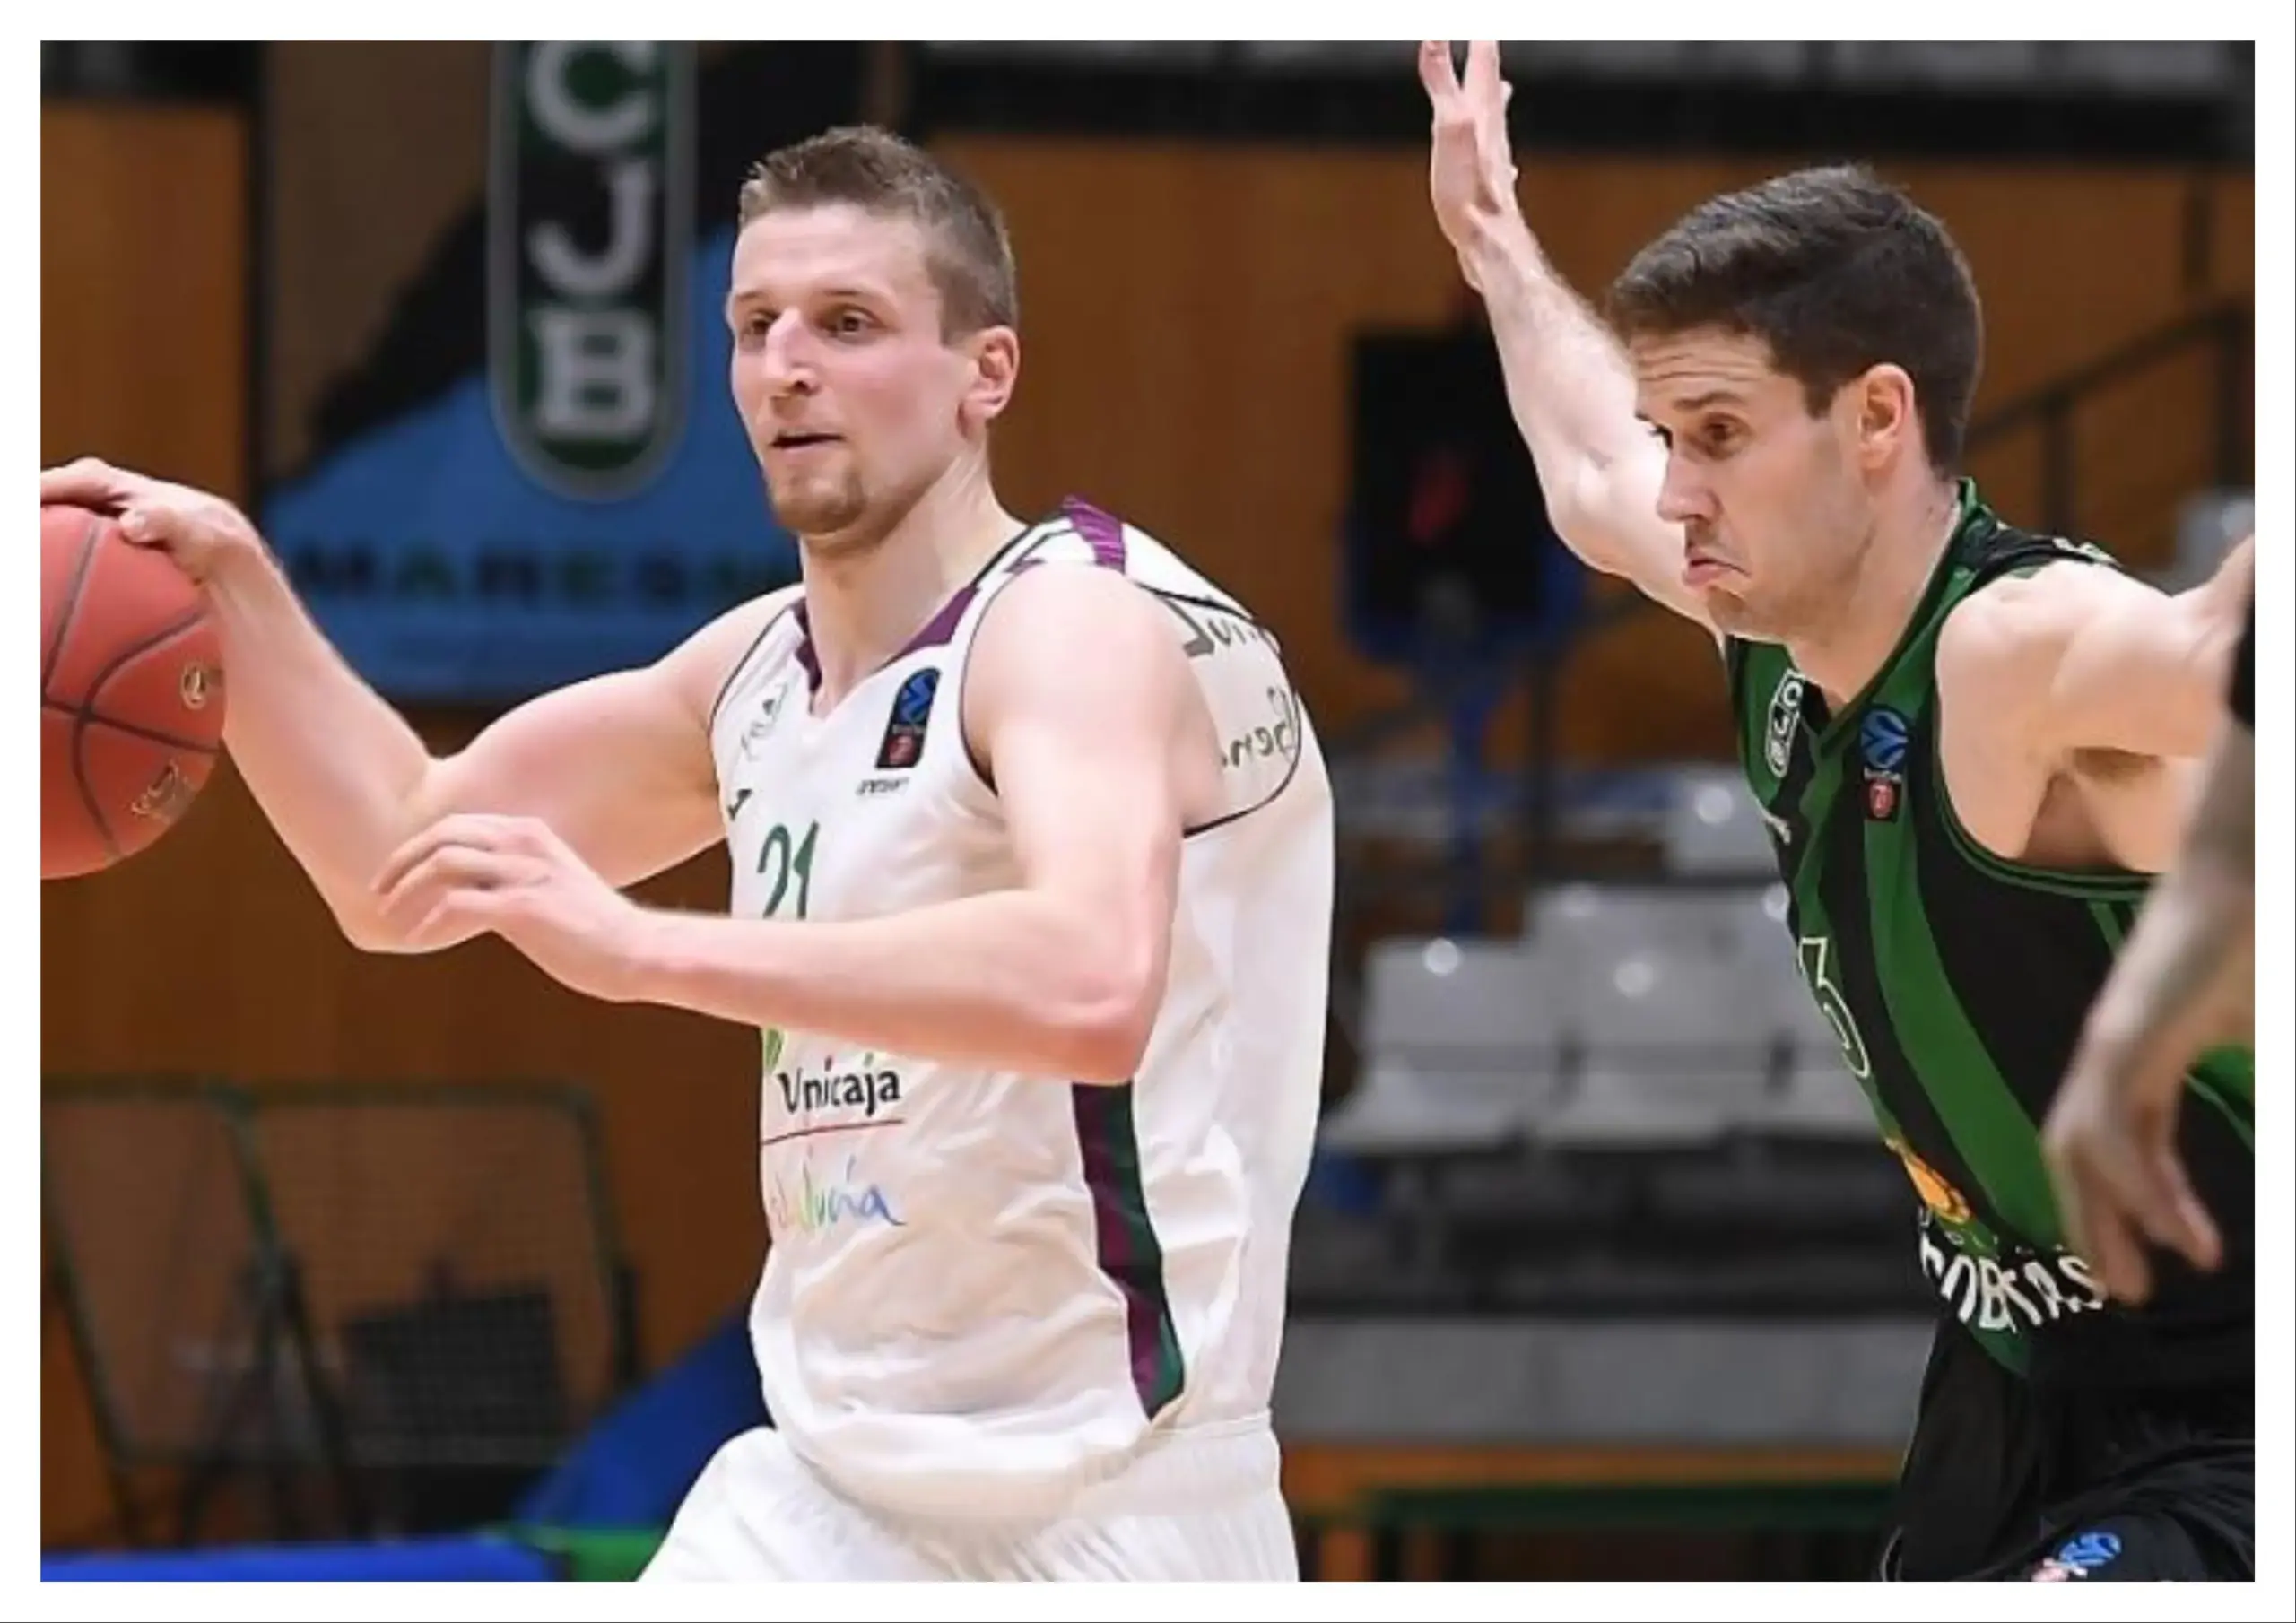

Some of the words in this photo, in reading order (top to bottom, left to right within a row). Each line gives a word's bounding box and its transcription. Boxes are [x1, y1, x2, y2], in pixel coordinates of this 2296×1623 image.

[526, 41, 664, 441] CJB
[756, 820, 820, 921] 21
[778, 1051, 902, 1117] Unicaja
